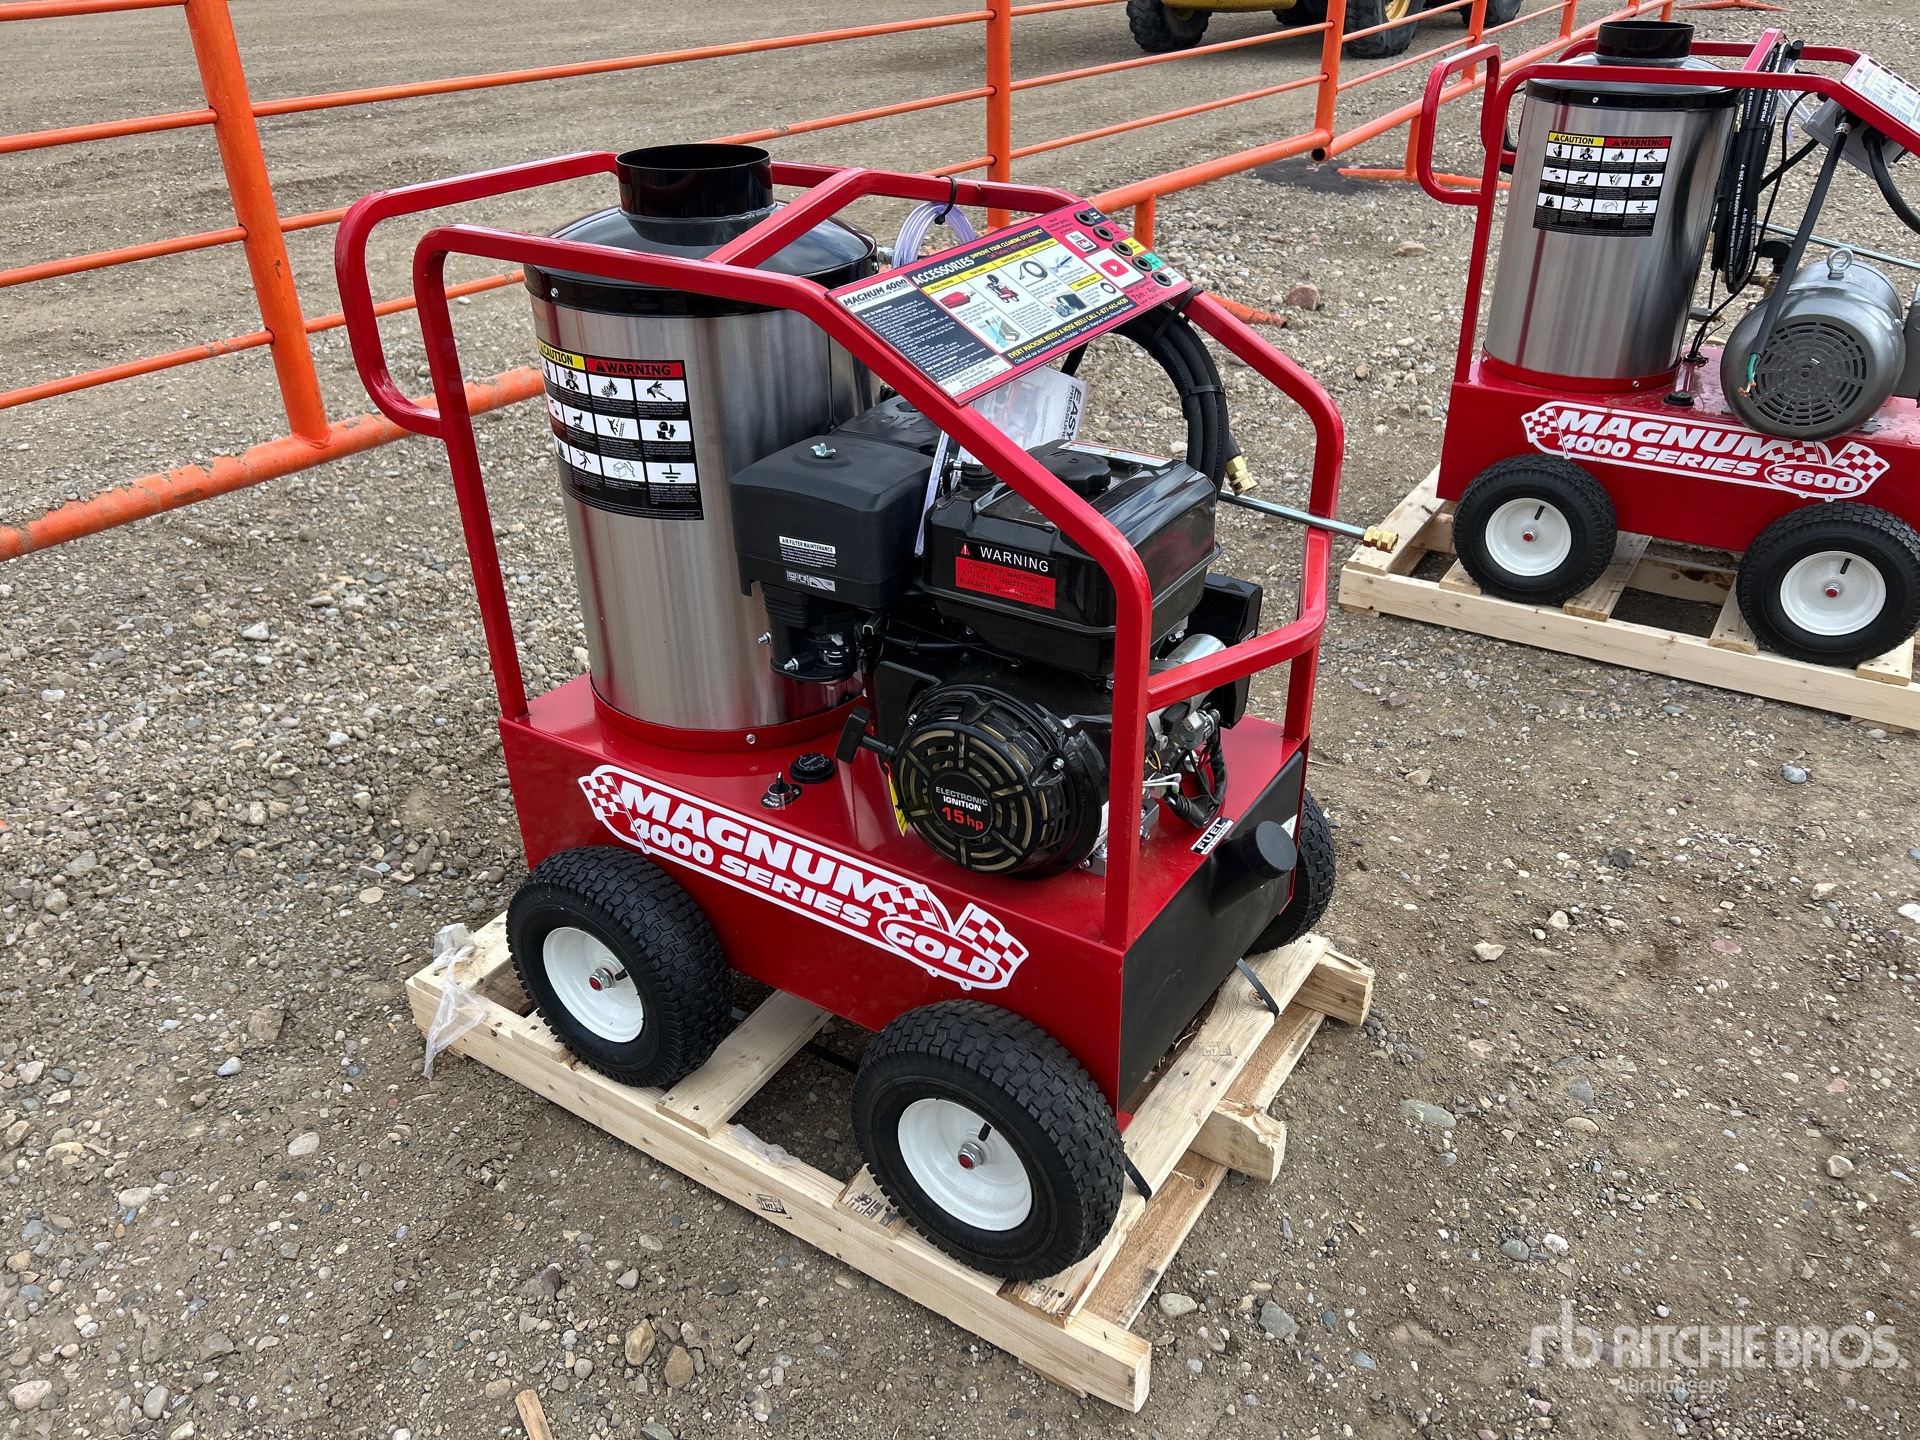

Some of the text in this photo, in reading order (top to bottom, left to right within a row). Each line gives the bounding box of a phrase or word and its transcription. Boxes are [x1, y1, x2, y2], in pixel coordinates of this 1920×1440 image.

[1560, 135, 1594, 145] CAUTION
[1621, 138, 1663, 147] WARNING
[911, 257, 975, 285] ACCESSORIES
[843, 279, 908, 307] MAGNUM 4000
[543, 344, 573, 366] CAUTION
[1007, 348, 1024, 359] EVERY
[1022, 338, 1046, 351] MACHINE
[1043, 331, 1060, 341] NEEDS
[605, 361, 672, 376] WARNING
[1067, 387, 1082, 440] EASY
[1558, 409, 1777, 462] MAGNUM
[1559, 434, 1762, 476] 4000 SERIES
[1770, 467, 1858, 492] 3600
[804, 542, 833, 553] MAINTENANCE
[980, 546, 1049, 572] WARNING
[968, 563, 1041, 585] OPERATE MACHINE
[974, 572, 991, 582] FULL
[995, 576, 1034, 592] THROTTLE
[960, 578, 991, 591] BURNER
[1032, 594, 1049, 604] FIRE
[935, 786, 988, 806] ELECTRONIC
[943, 795, 982, 812] IGNITION
[618, 777, 897, 908] MAGNUM
[1196, 821, 1226, 850] FUEL
[628, 816, 872, 928] 4000 SERIES
[884, 921, 996, 982] GOLD
